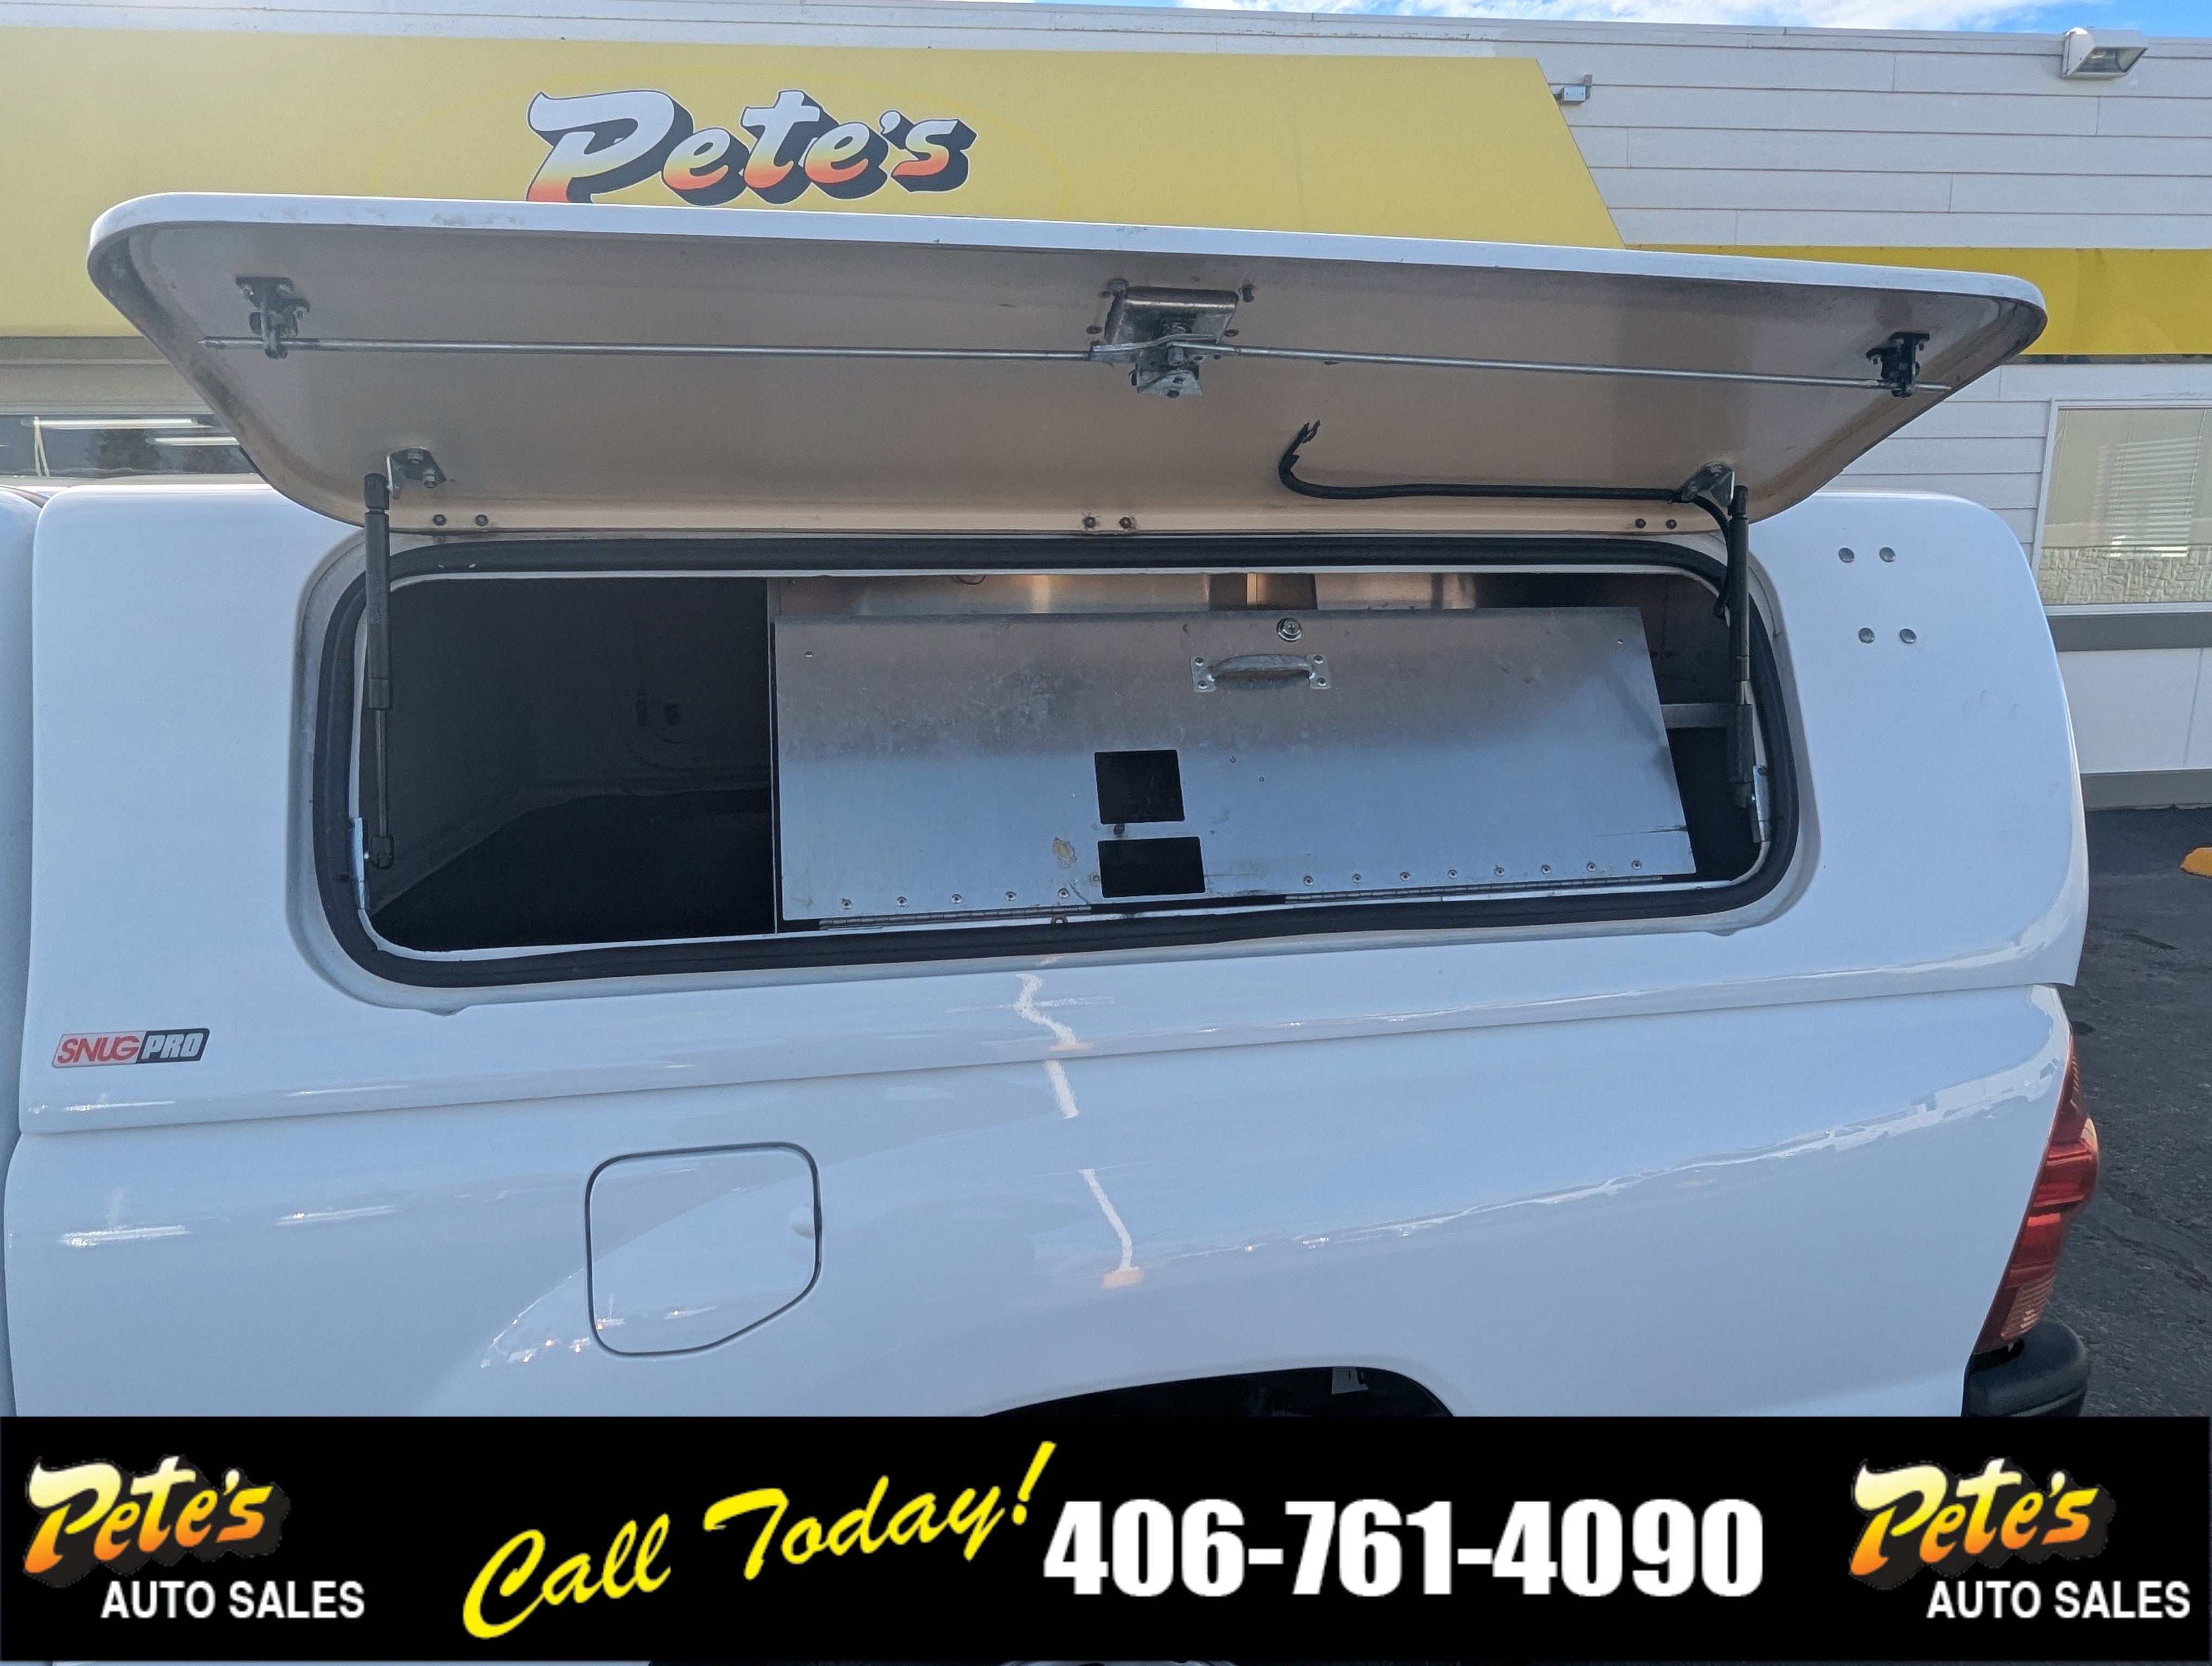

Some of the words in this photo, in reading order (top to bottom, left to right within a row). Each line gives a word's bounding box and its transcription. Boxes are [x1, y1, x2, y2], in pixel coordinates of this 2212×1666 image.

[526, 89, 968, 203] Pete's
[57, 1036, 139, 1063] SNUG
[140, 1033, 204, 1059] PRO
